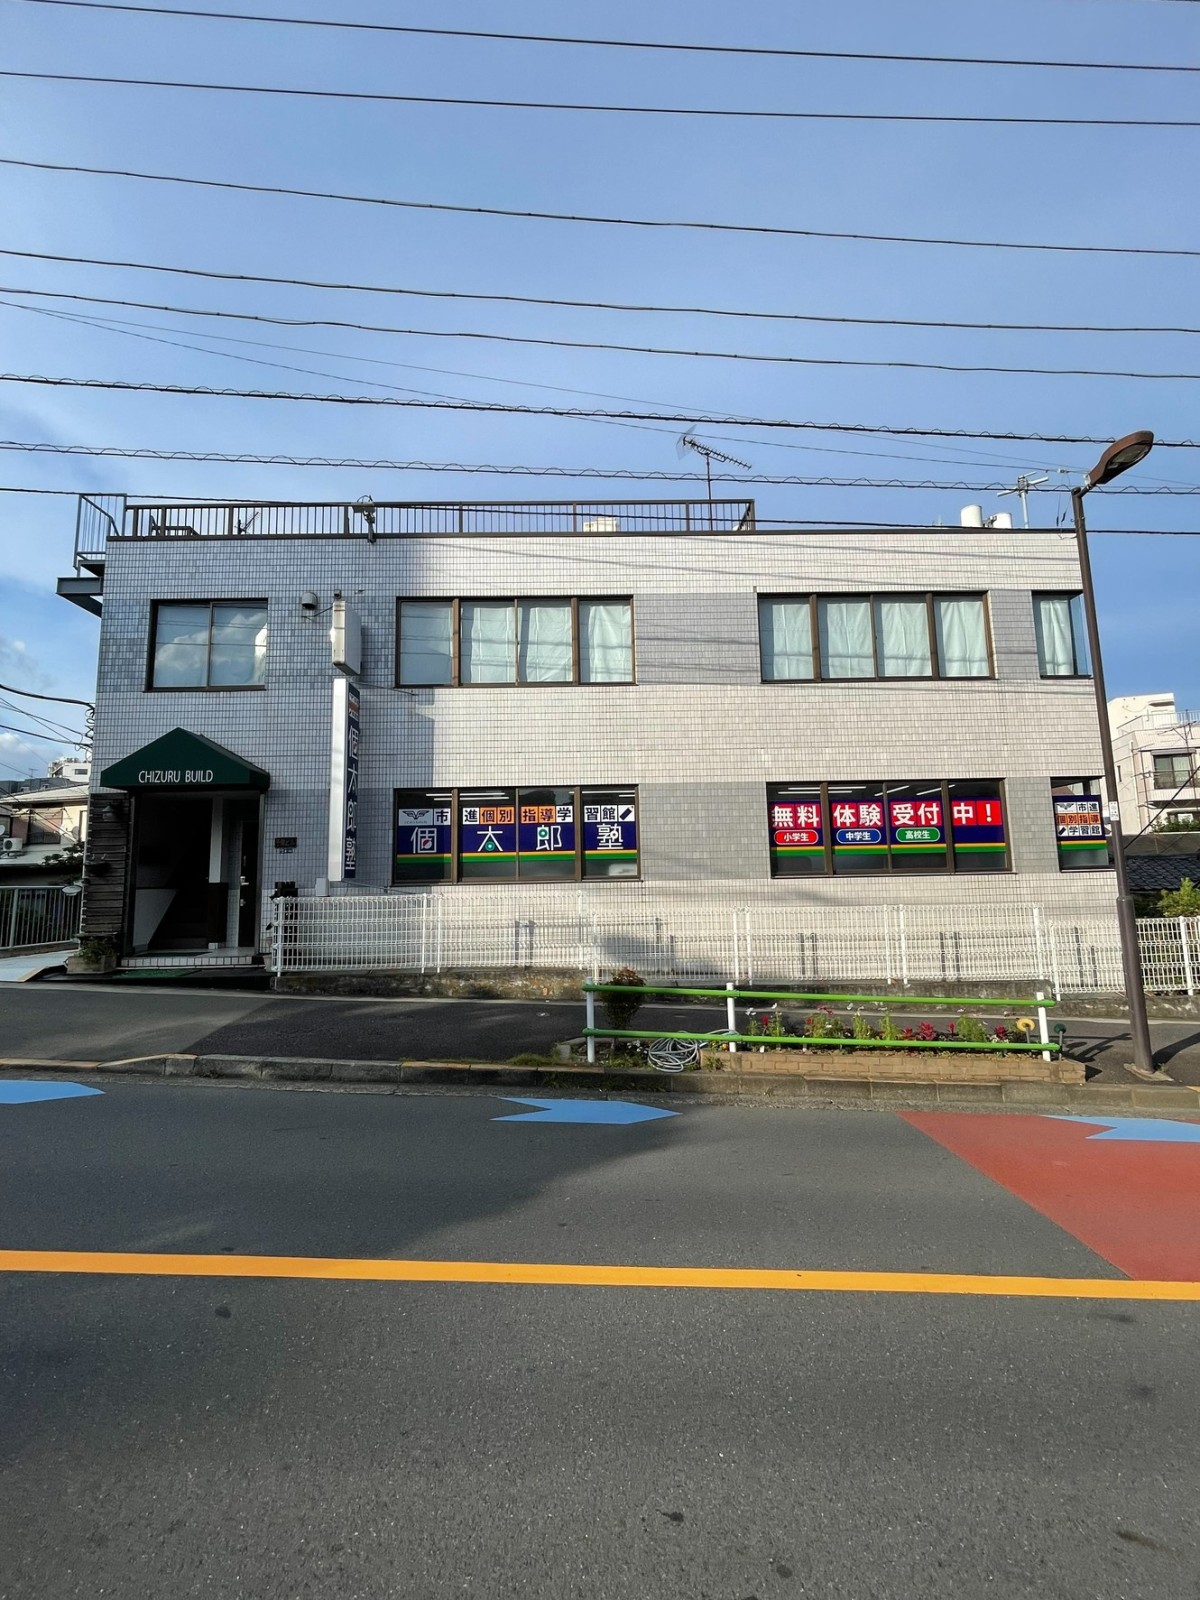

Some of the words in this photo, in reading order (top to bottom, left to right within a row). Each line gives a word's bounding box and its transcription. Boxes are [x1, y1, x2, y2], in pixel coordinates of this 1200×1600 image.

[138, 770, 181, 783] CHIZURU
[185, 769, 214, 783] BUILD
[1078, 803, 1098, 811] 市進
[435, 807, 616, 824] 市進個別指導学習館
[1057, 814, 1100, 824] 個別指導
[905, 830, 931, 840] 高校生
[1069, 825, 1101, 836] 学習館
[410, 823, 624, 854] 個太郎塾
[783, 832, 810, 842] 小学生
[845, 831, 872, 841] 中学生
